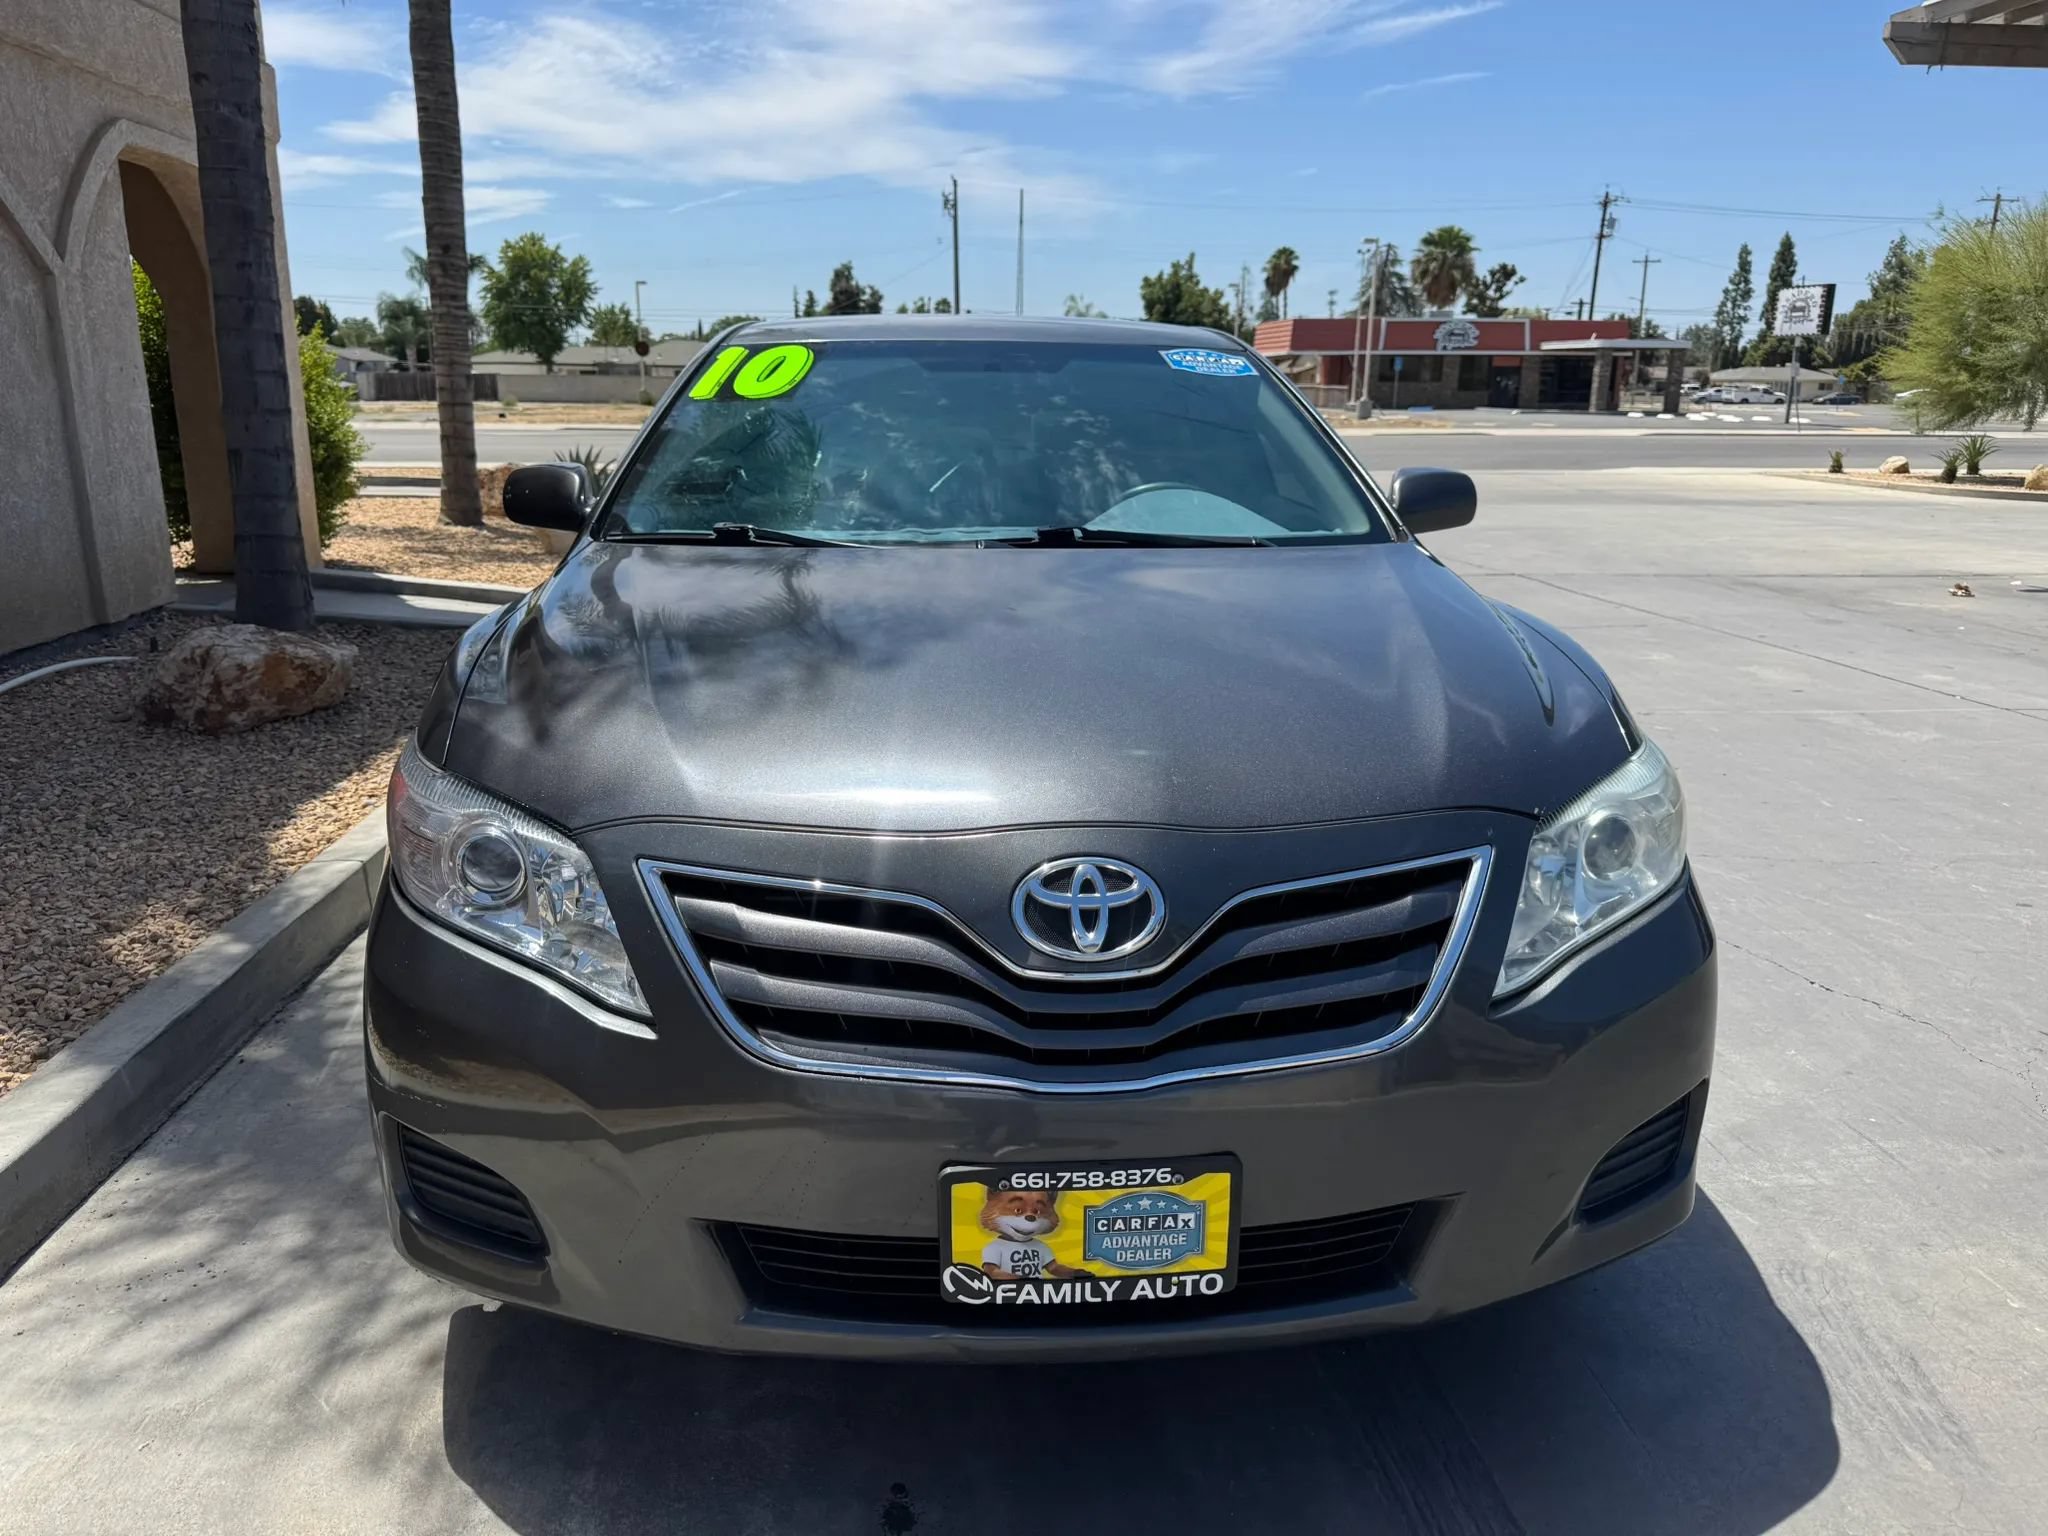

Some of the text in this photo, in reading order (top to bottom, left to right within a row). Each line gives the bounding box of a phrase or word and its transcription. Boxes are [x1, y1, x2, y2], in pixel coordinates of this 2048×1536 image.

[688, 344, 815, 400] 10
[1011, 1168, 1171, 1189] 661-758-8376
[1096, 1216, 1194, 1233] CARFAX
[1102, 1233, 1187, 1249] ADVANTAGE
[1010, 1250, 1040, 1263] CAR
[1116, 1248, 1172, 1263] DEALER
[1011, 1263, 1041, 1276] FOX
[996, 1273, 1224, 1305] FAMILY AUTO
